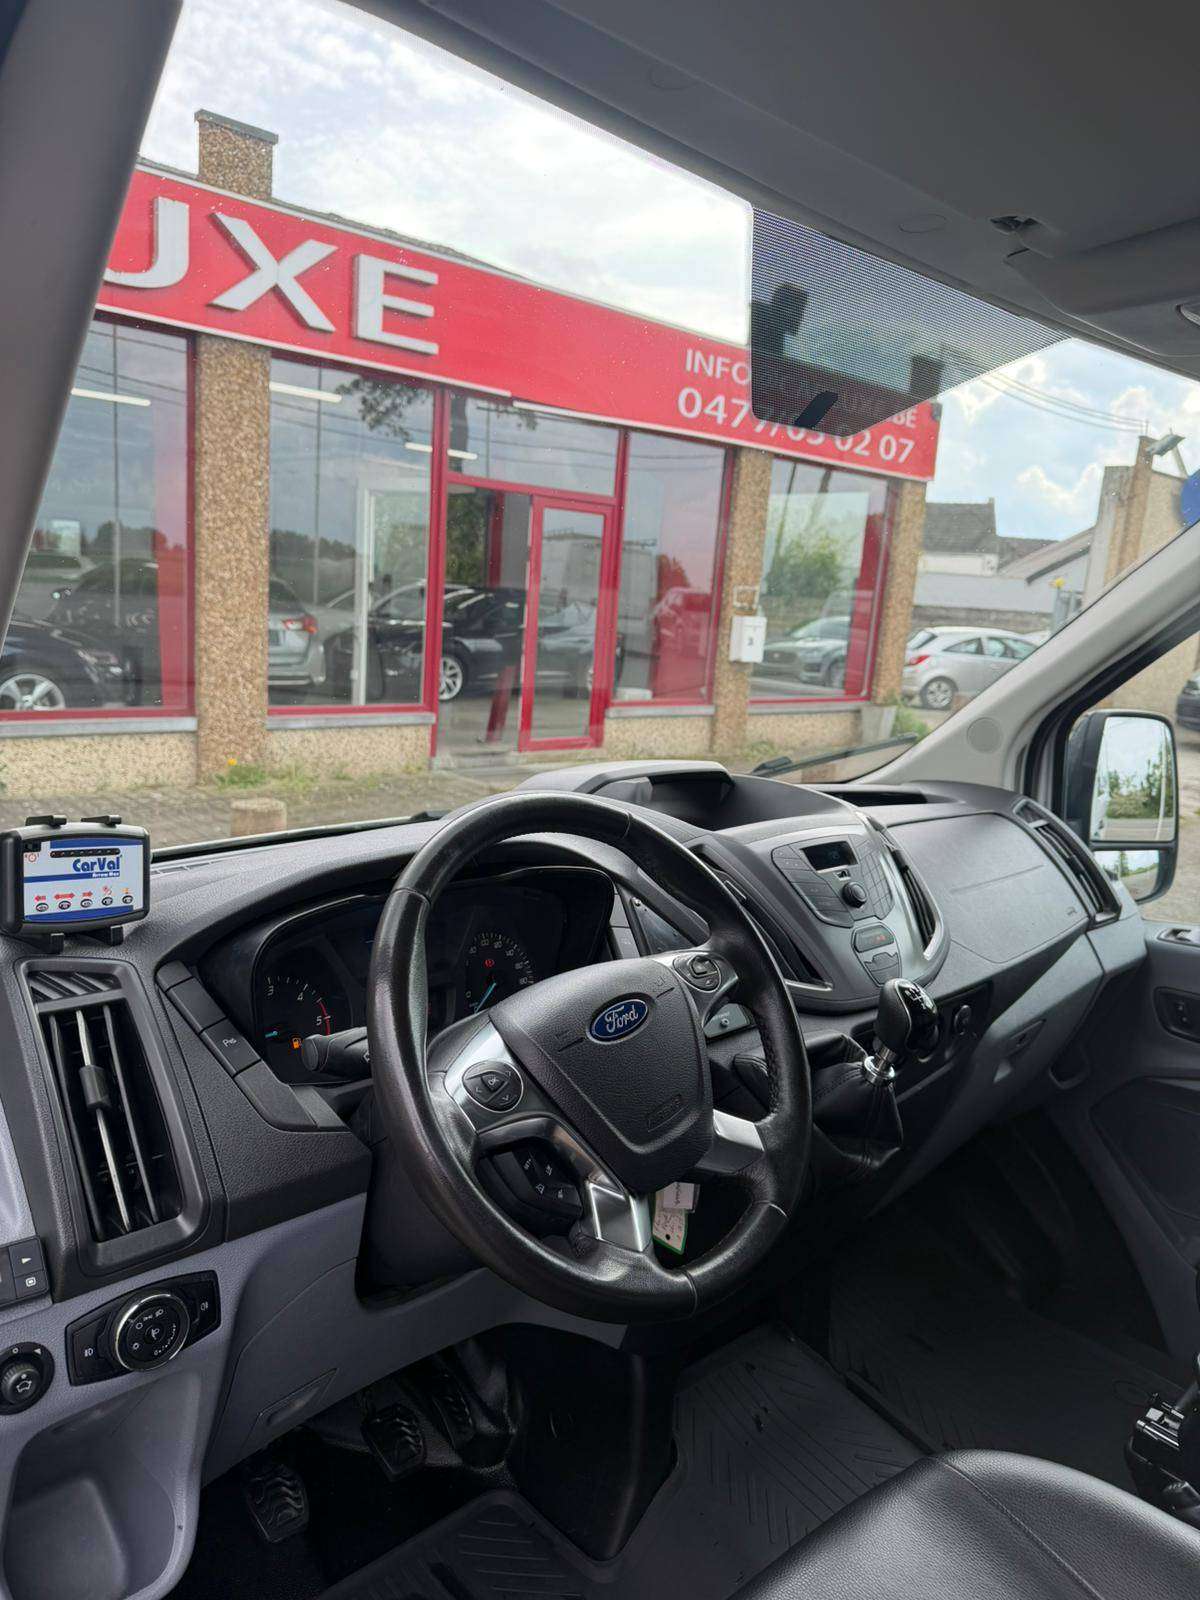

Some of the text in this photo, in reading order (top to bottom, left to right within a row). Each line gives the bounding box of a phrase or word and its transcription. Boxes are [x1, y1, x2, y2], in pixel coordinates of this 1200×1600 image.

[879, 435, 916, 463] 07
[72, 856, 120, 872] CarVal
[604, 1004, 639, 1033] Ford
